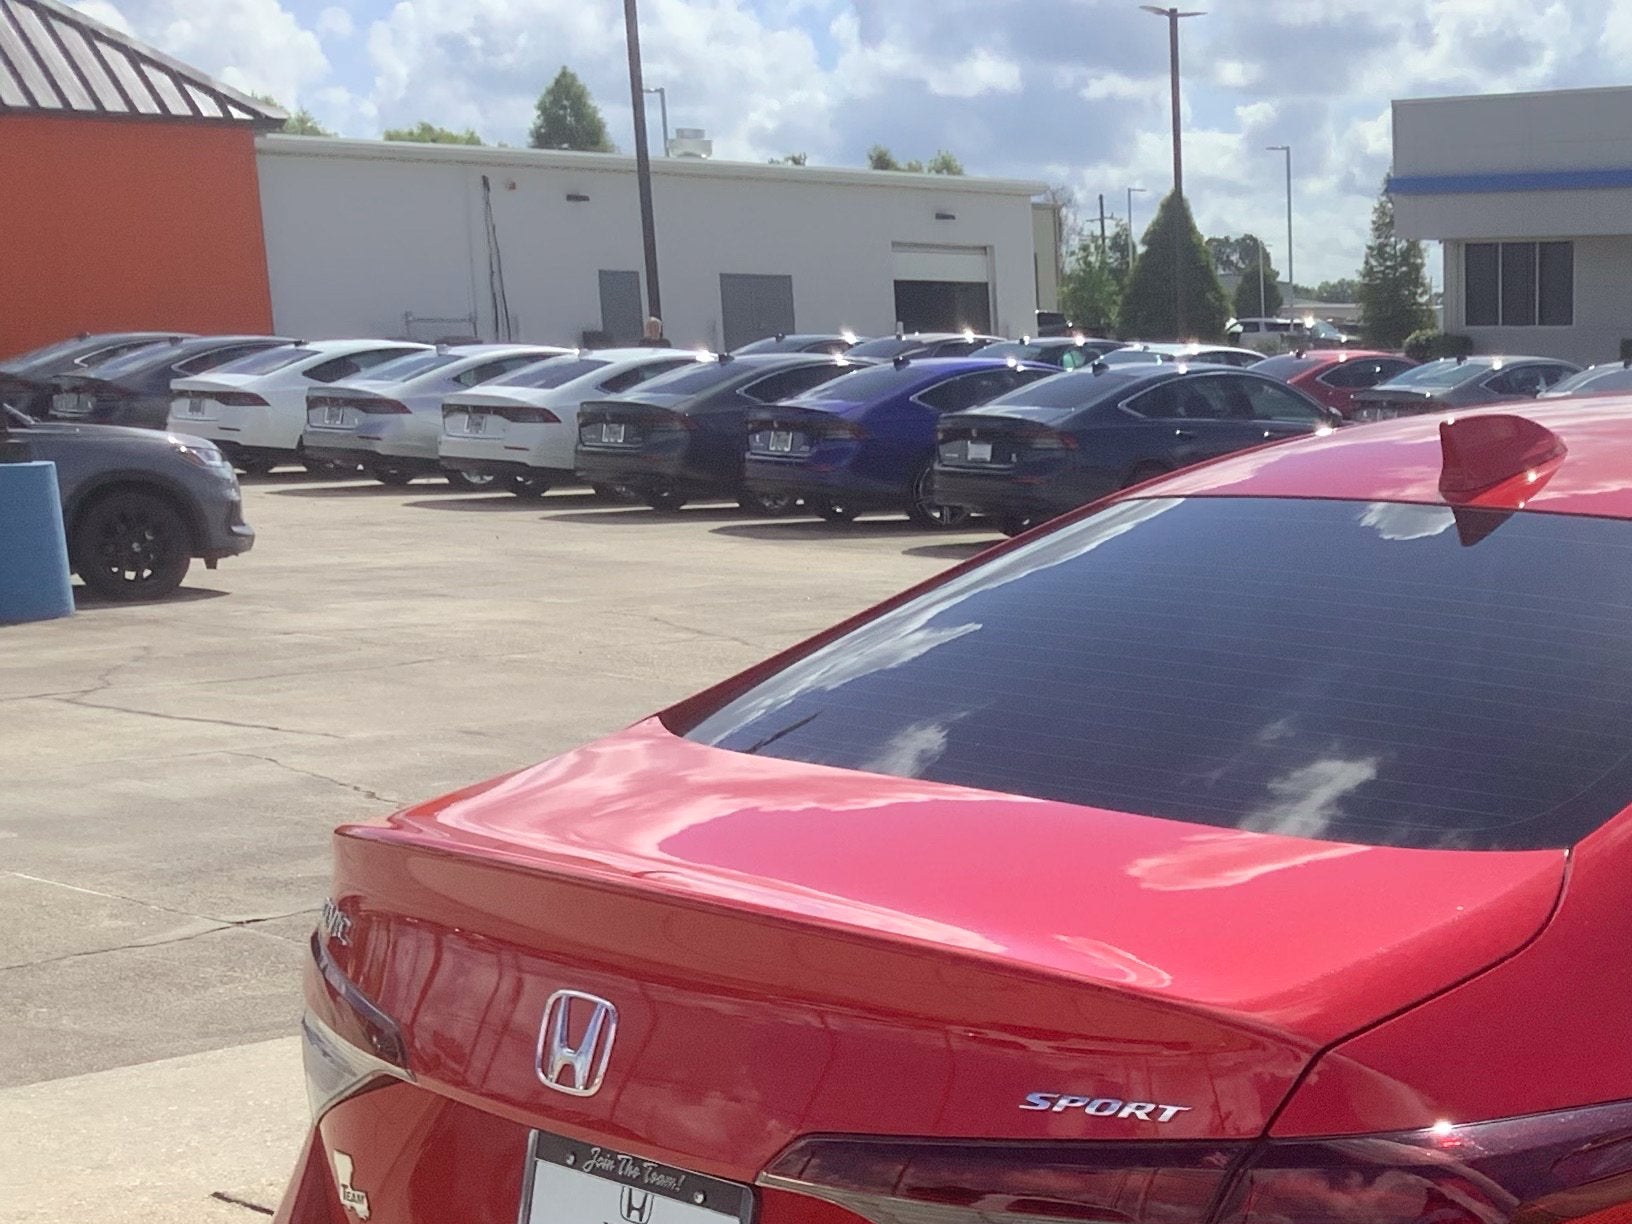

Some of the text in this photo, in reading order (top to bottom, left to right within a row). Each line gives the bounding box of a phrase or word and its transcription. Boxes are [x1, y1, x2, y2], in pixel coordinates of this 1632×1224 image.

[1018, 1091, 1193, 1123] SPORT
[583, 1147, 686, 1192] Join The Team!
